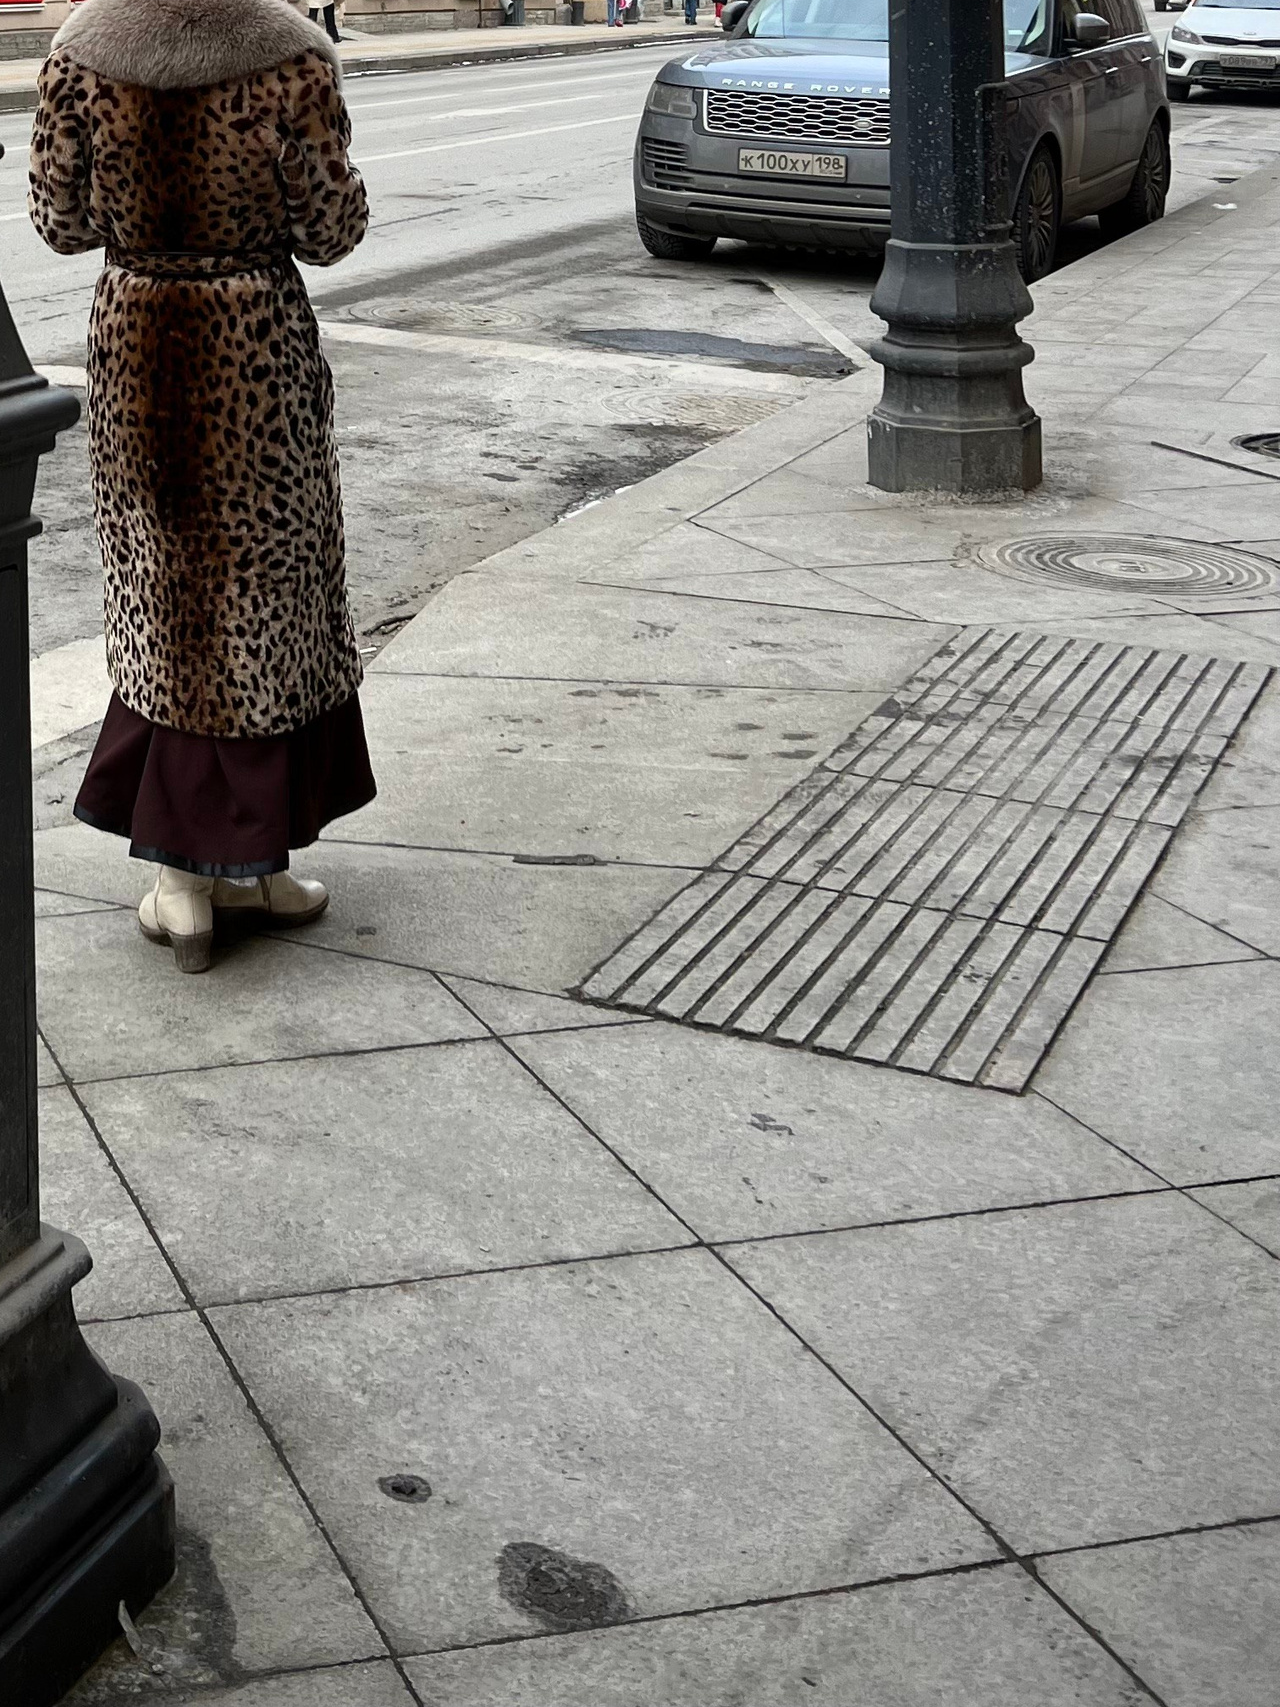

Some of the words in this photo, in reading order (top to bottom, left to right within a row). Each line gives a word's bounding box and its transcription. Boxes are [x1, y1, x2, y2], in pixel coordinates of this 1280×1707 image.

[722, 78, 795, 90] RANGE
[810, 84, 890, 94] ROVER
[815, 156, 841, 170] 198
